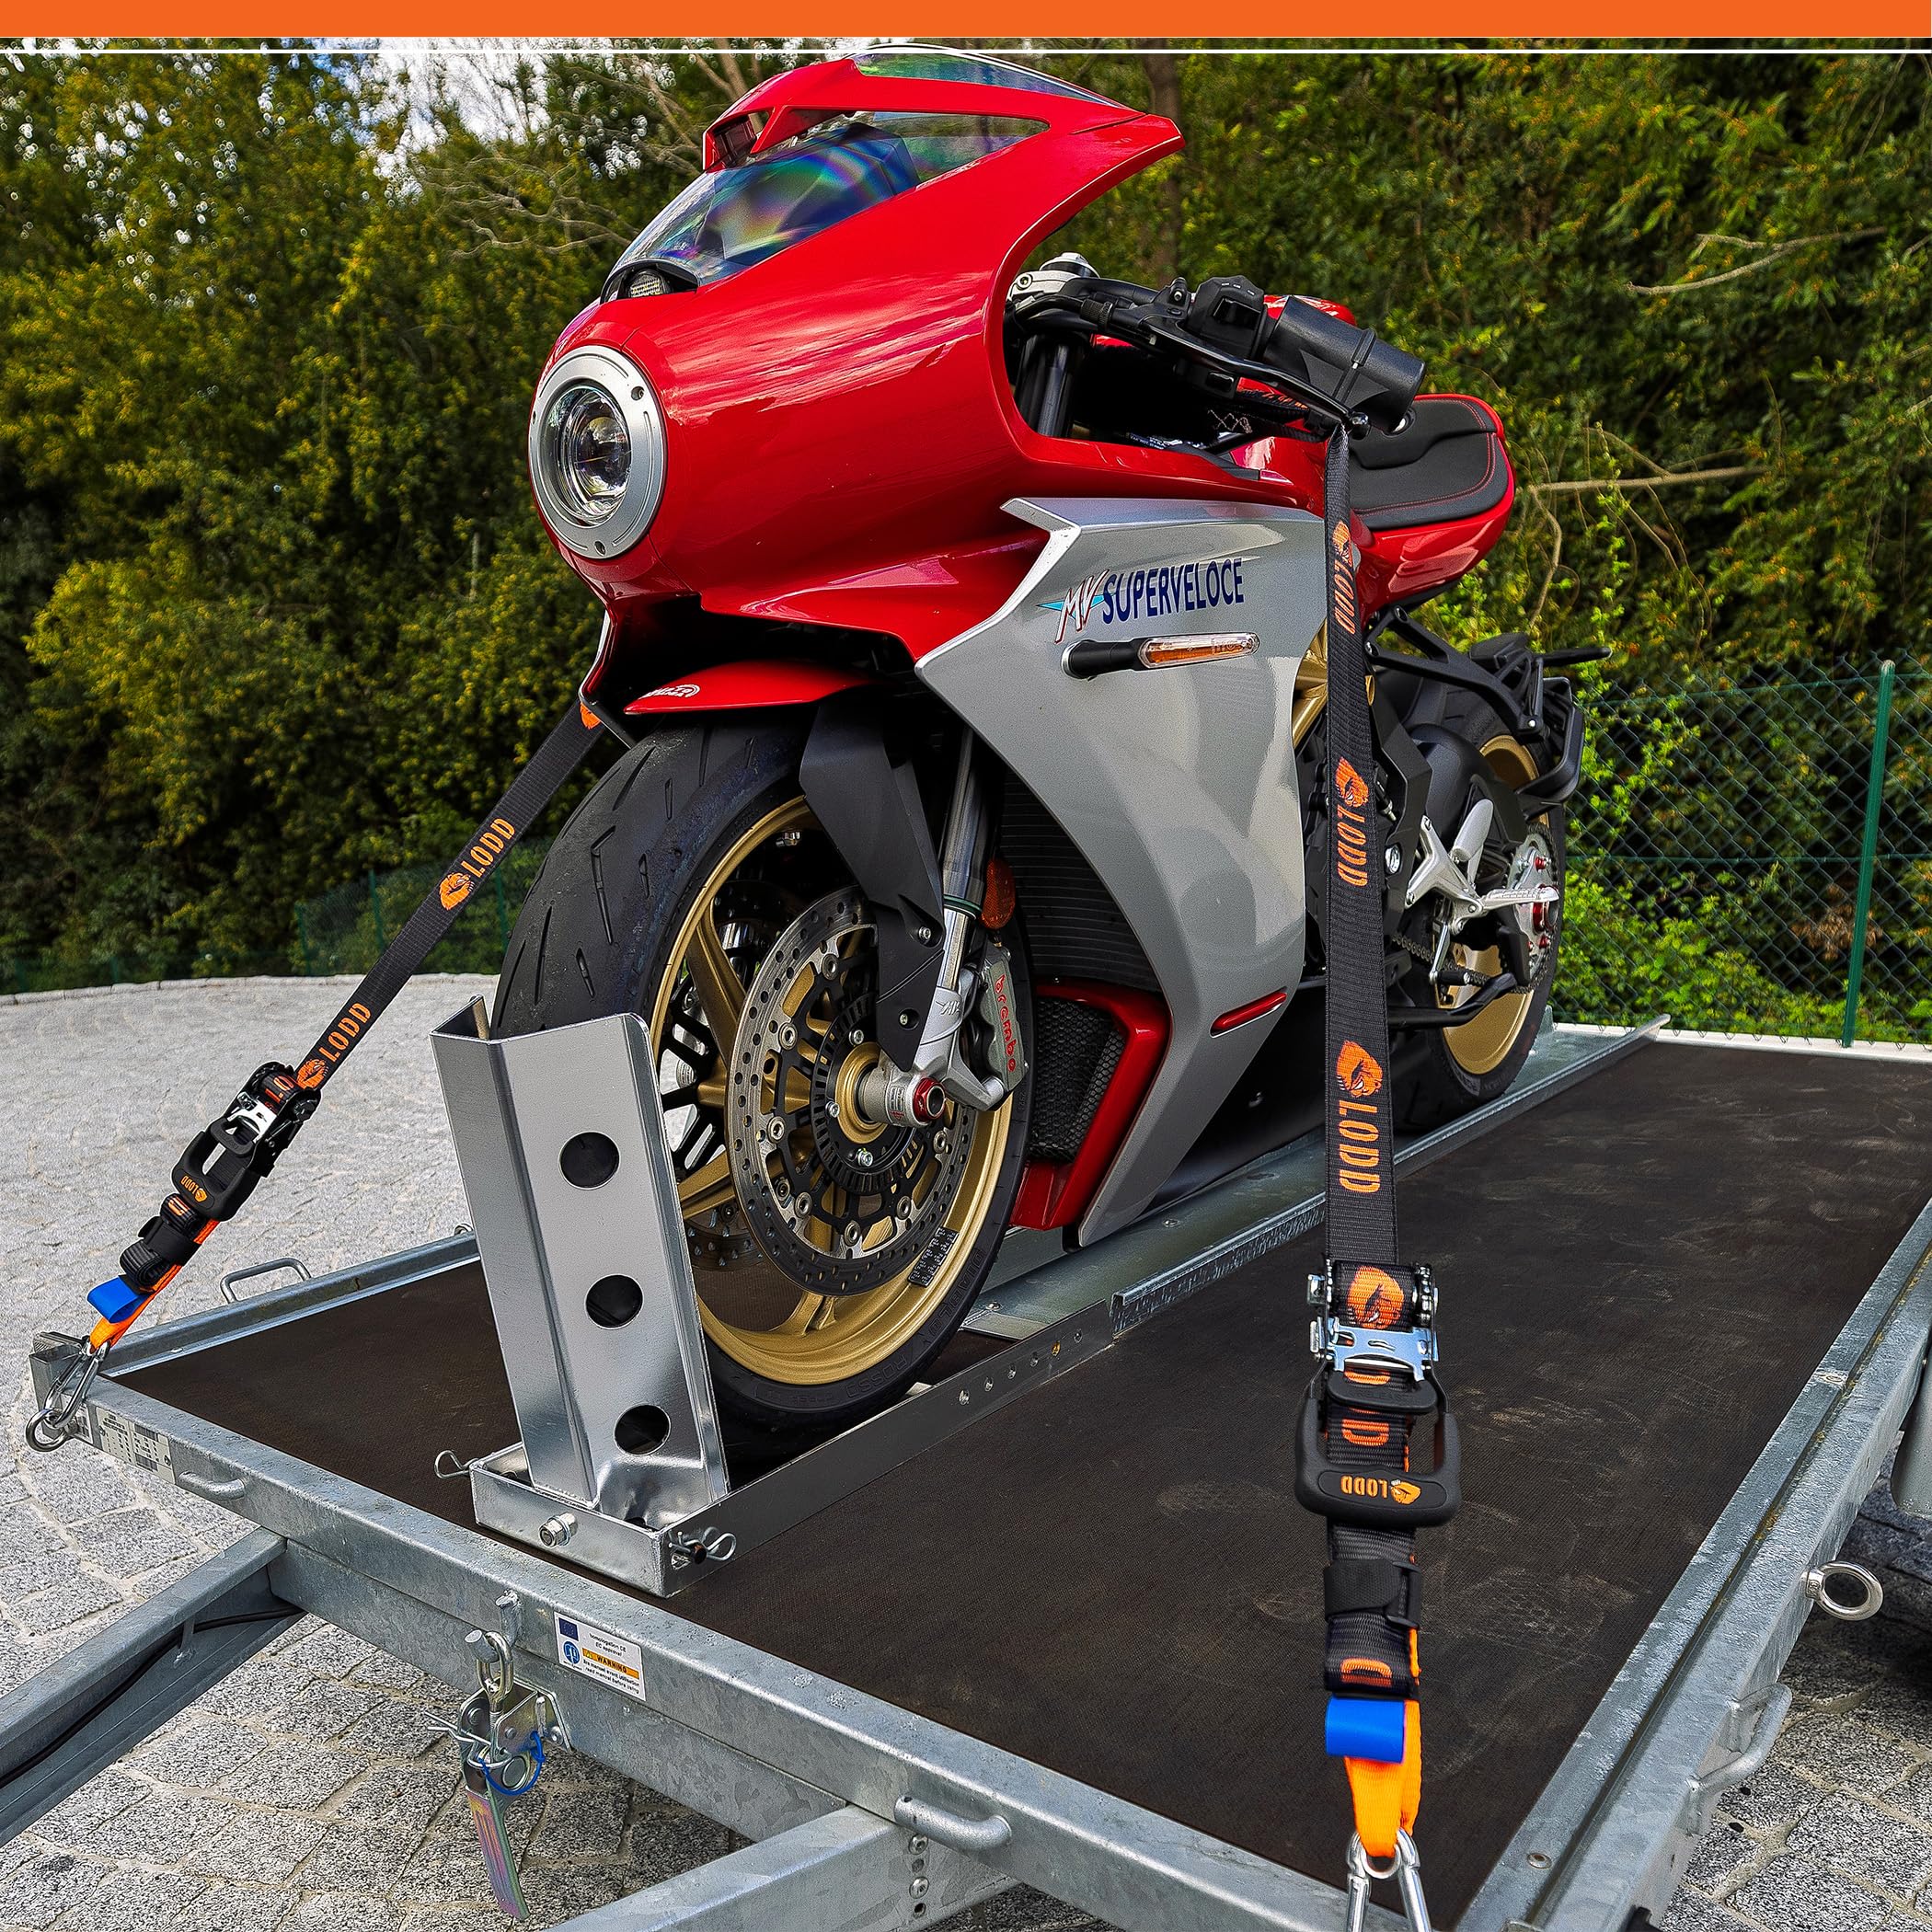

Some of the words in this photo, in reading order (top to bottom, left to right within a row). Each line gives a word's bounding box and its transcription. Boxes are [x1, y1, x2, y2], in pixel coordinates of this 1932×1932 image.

[1102, 558, 1245, 625] SUPERVELOCE
[1334, 559, 1356, 635] LODD
[461, 818, 515, 878] LODD
[1337, 803, 1368, 887] LODD
[318, 1003, 372, 1063] LODD
[995, 973, 1018, 1073] brembo
[264, 1075, 294, 1104] LO
[1339, 1099, 1381, 1193] LODD
[180, 1175, 200, 1195] LODD
[1340, 1474, 1389, 1499] LODD
[596, 1655, 627, 1673] WARNING
